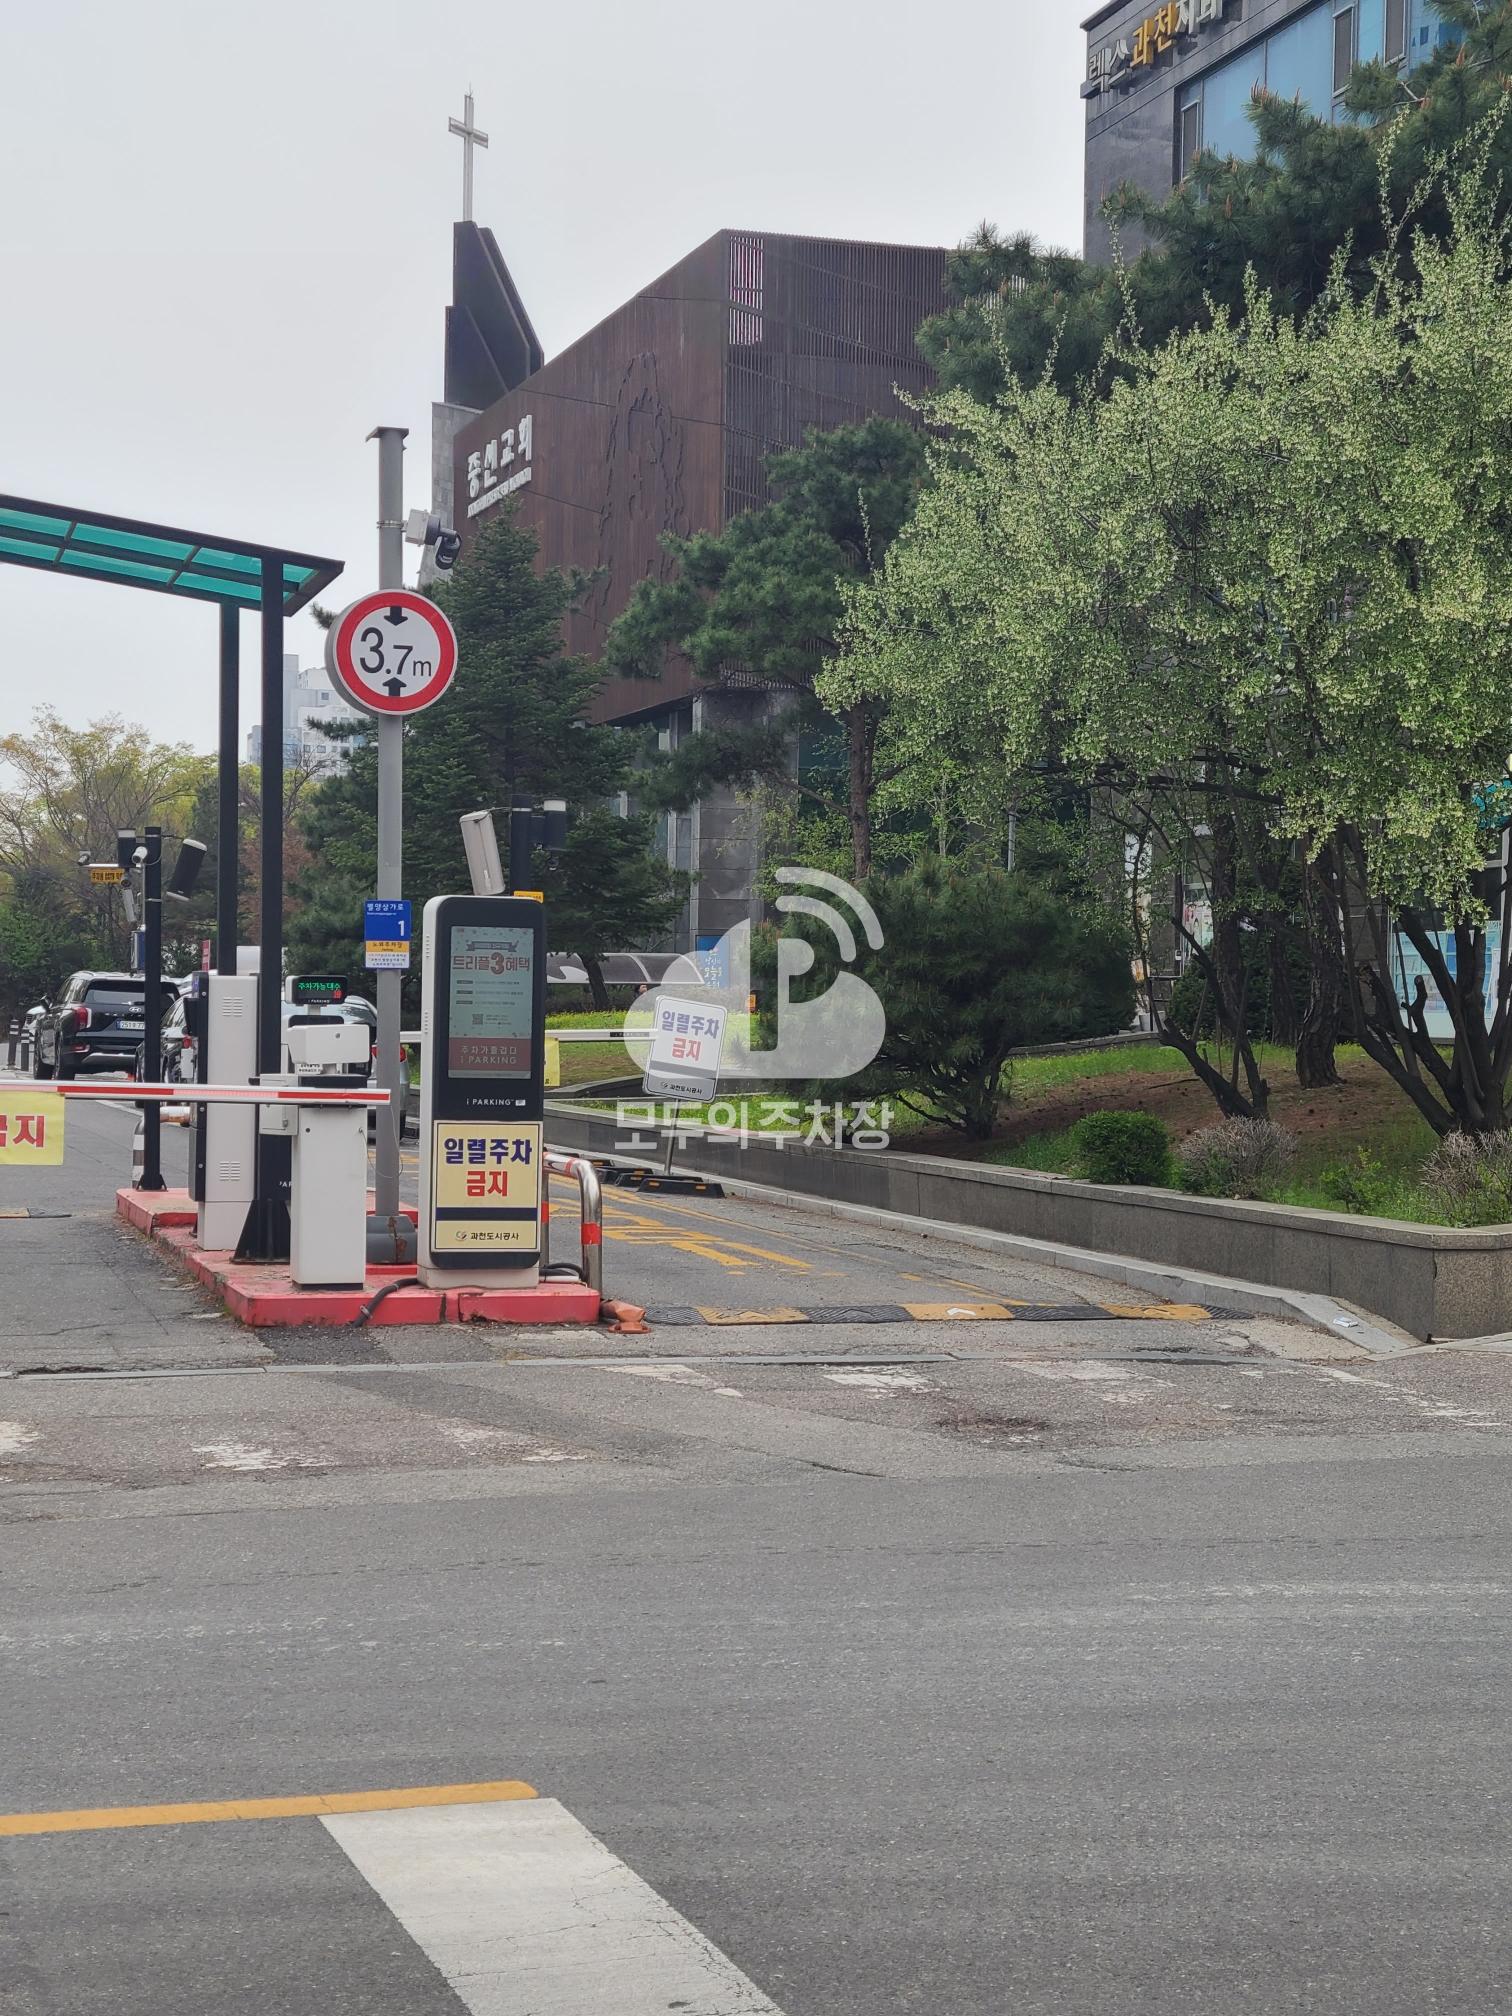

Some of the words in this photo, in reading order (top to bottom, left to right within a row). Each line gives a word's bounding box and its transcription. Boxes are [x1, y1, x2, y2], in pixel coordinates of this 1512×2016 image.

[359, 626, 432, 676] 3.7m
[397, 920, 405, 937] 1
[662, 1010, 720, 1039] 일렬주차
[468, 1056, 517, 1065] PARKING
[672, 1037, 702, 1061] 금지
[472, 1098, 511, 1106] PARKING
[0, 1114, 45, 1149] 지
[444, 1138, 533, 1165] 일렬주차
[467, 1170, 508, 1197] 금지
[470, 1232, 520, 1241] 과천도시공사
